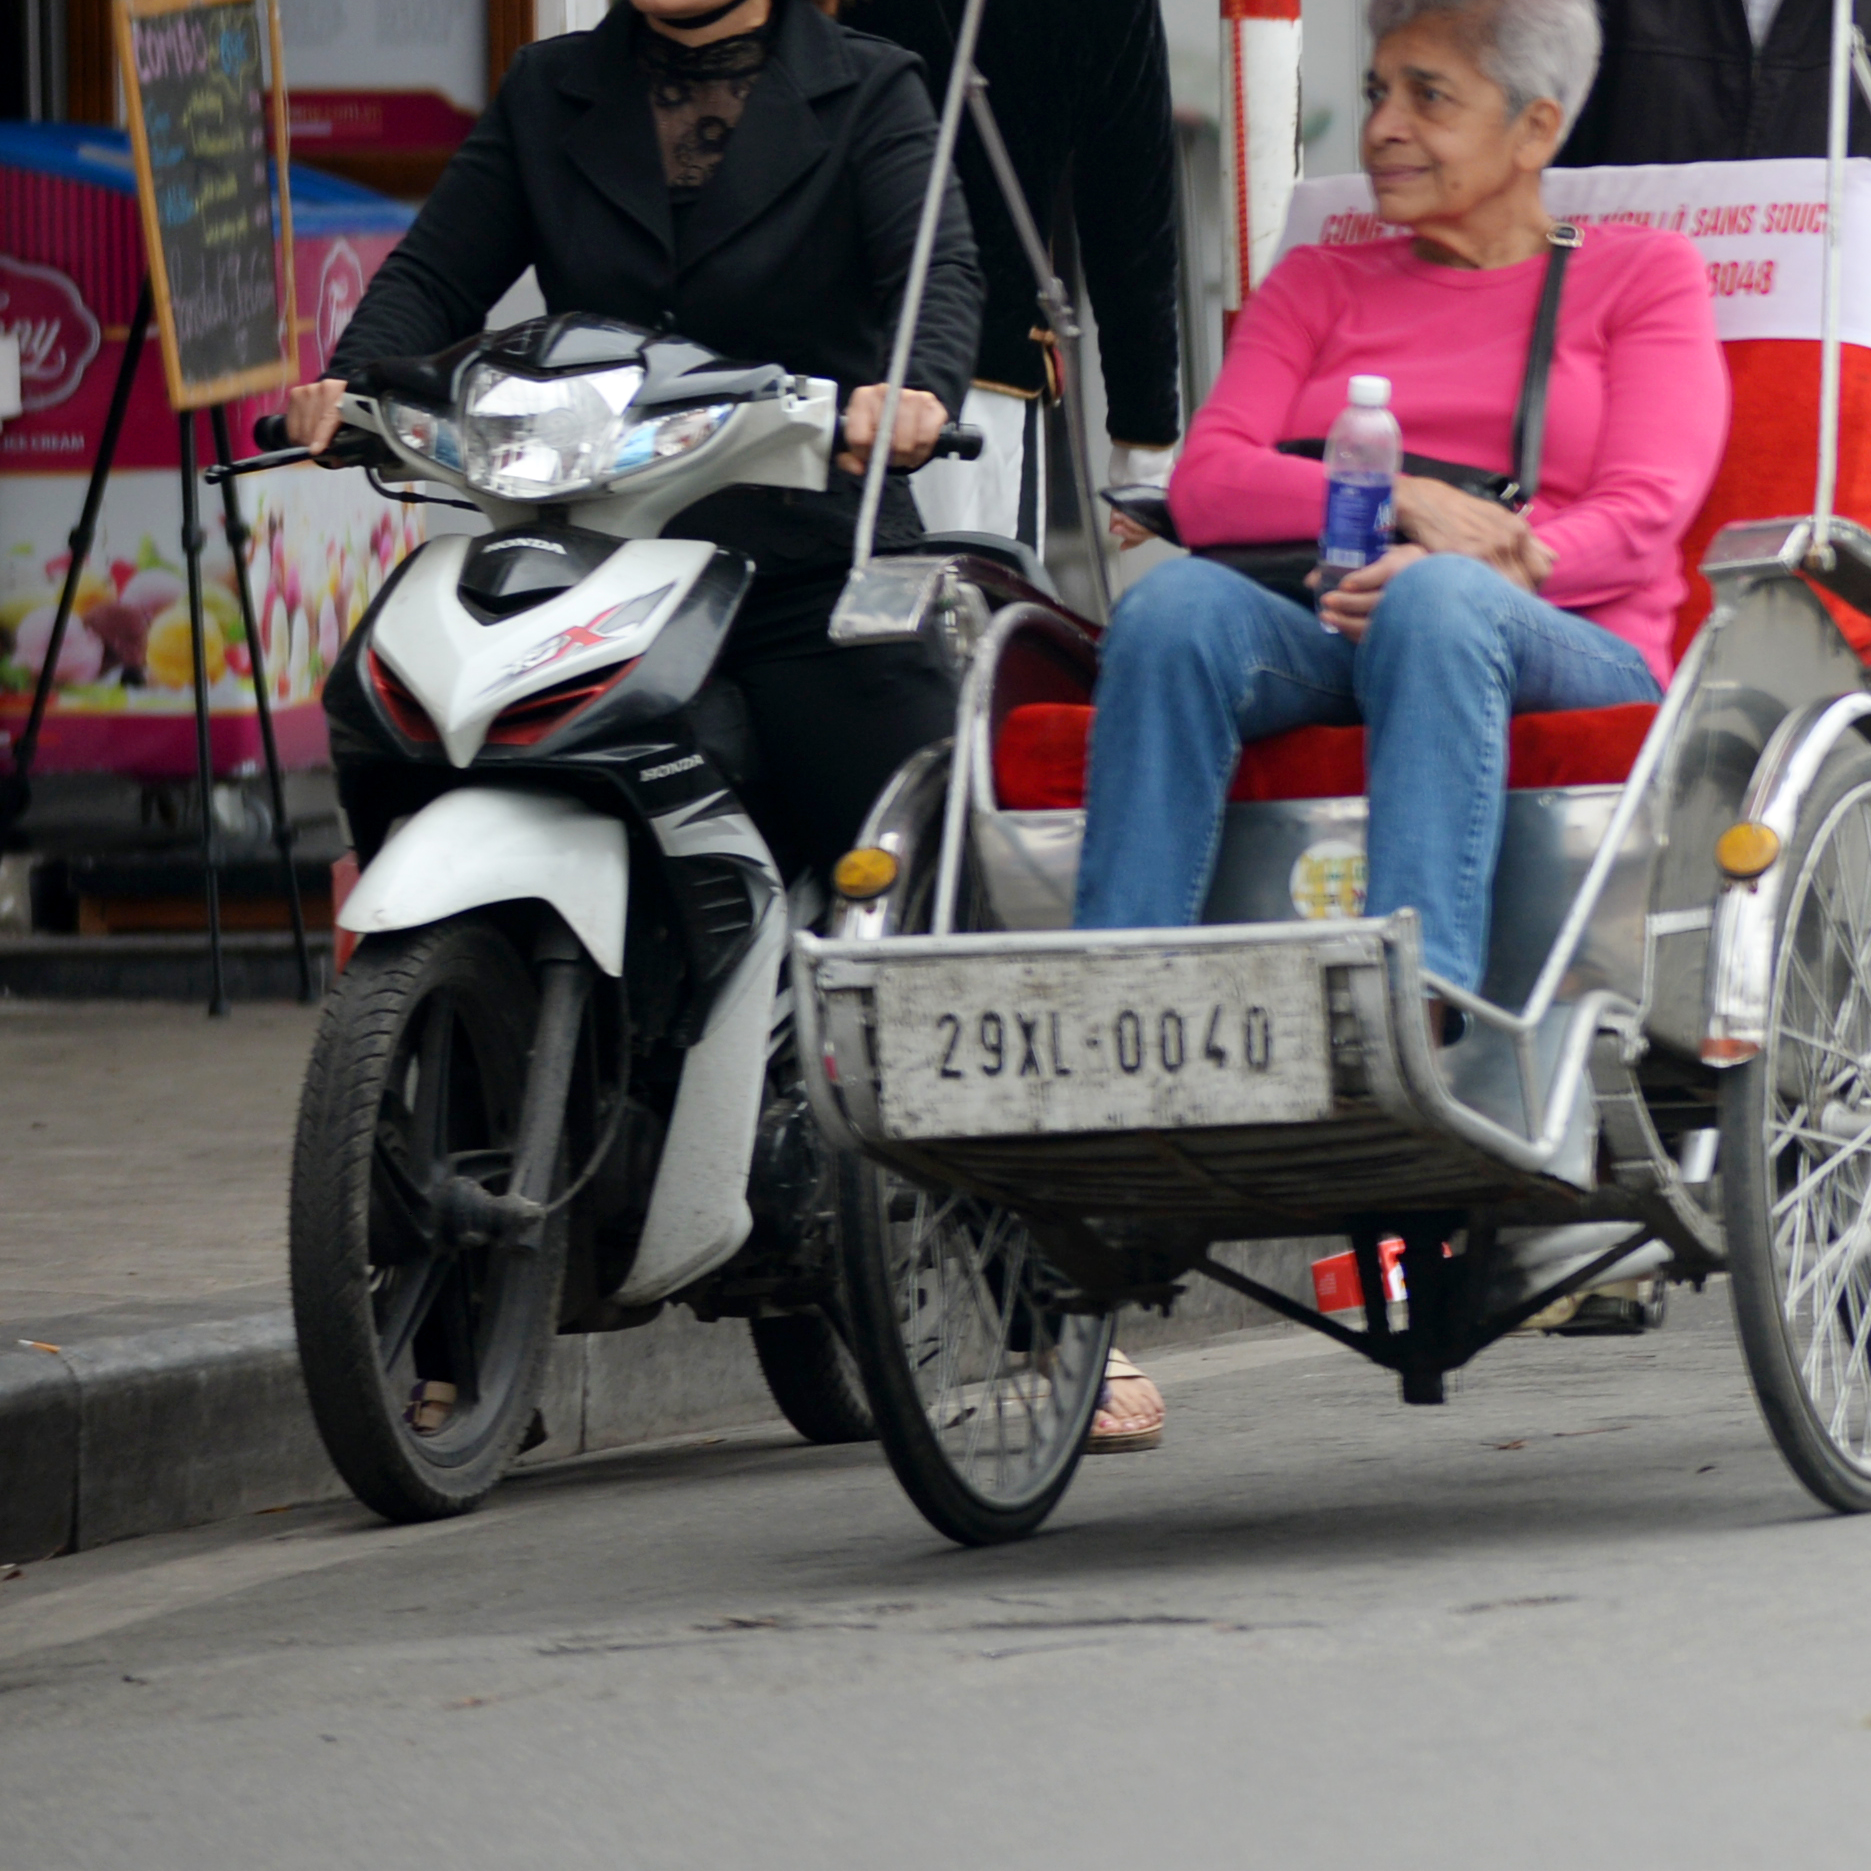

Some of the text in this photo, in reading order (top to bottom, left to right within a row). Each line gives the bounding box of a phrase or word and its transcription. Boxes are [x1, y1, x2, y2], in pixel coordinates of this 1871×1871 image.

[1690, 204, 1757, 238] SANS
[482, 537, 569, 556] HONDA
[639, 753, 706, 783] HONDA
[936, 1004, 1273, 1080] 29XL-0040
